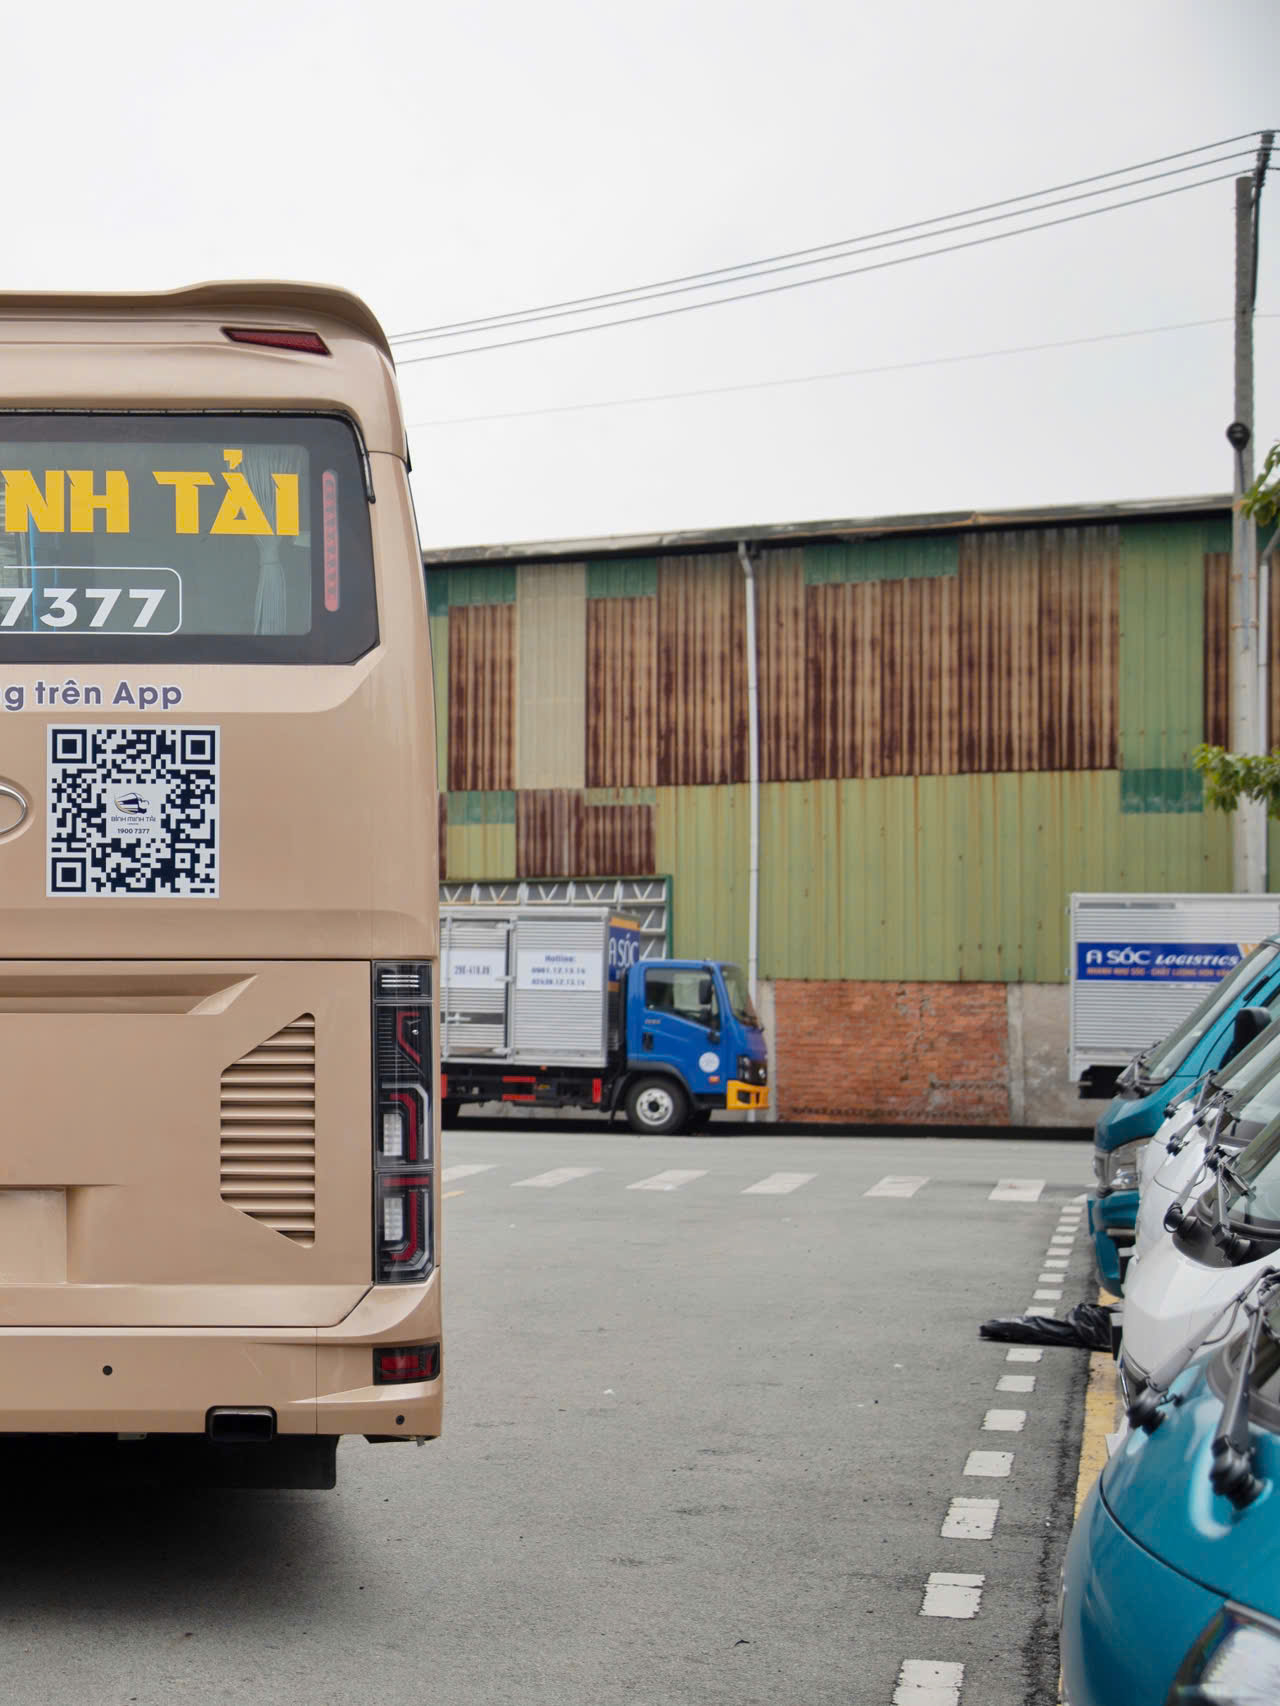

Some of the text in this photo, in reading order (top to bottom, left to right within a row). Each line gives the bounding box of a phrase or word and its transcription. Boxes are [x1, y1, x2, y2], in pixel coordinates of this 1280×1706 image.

[152, 449, 300, 536] TẢI
[35, 679, 102, 704] trên
[112, 681, 182, 710] App
[1086, 946, 1241, 967] A SÓC LOGISTICS
